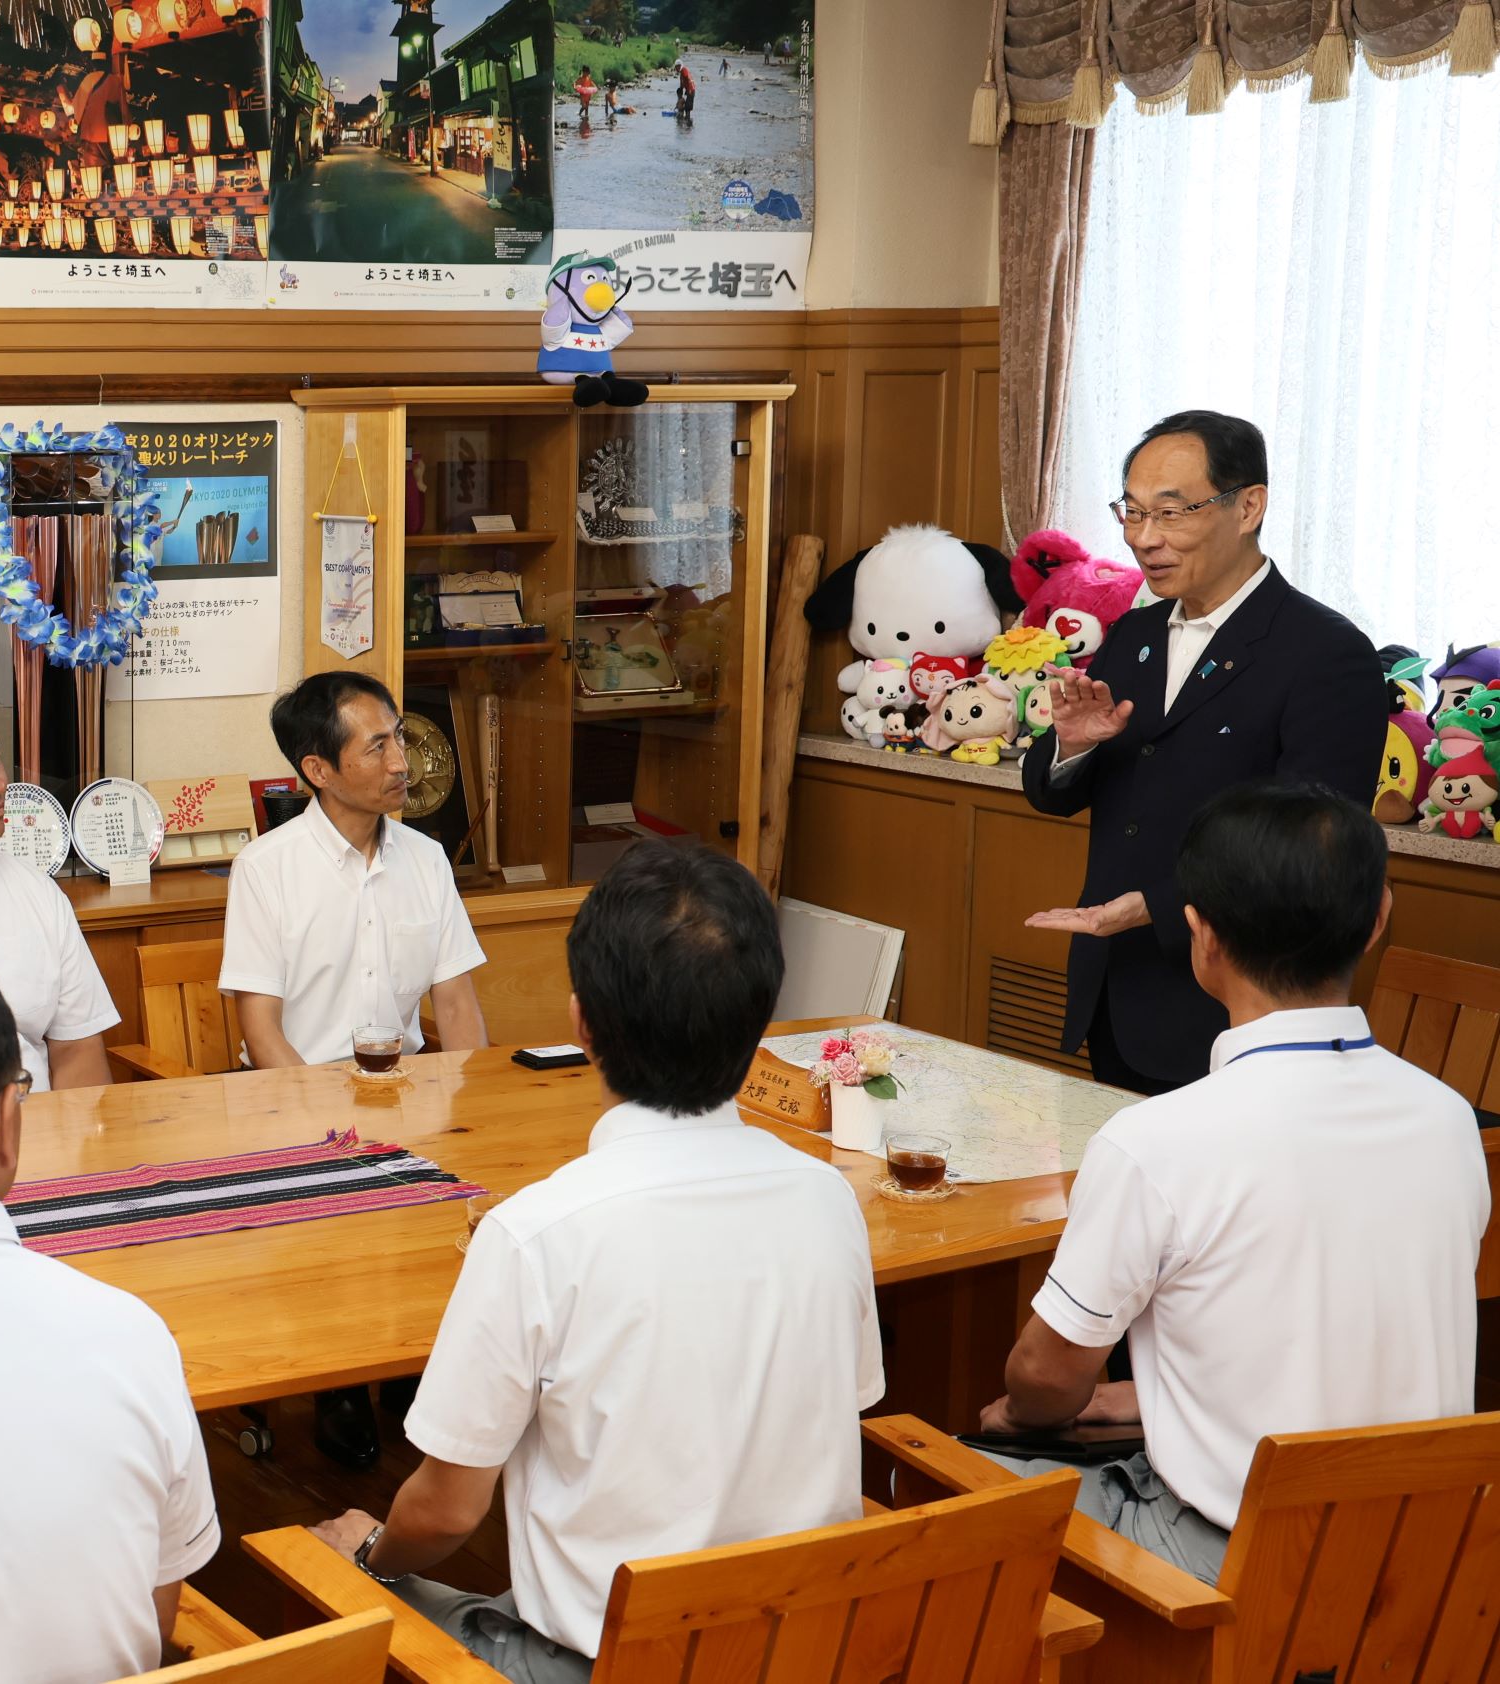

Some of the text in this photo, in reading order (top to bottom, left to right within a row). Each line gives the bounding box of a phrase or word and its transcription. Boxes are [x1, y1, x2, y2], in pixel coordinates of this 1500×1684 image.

[634, 239, 644, 250] TO
[644, 233, 676, 248] SAITAMA
[68, 264, 166, 278] ようこそ埼玉へ
[365, 268, 456, 282] ようこそ埼玉へ
[138, 450, 248, 466] 聖火リレートーチ
[211, 486, 230, 500] 2020
[325, 563, 338, 572] BEST
[760, 1069, 790, 1088] 埼玉県知事
[743, 1081, 800, 1115] 大野 元裕
